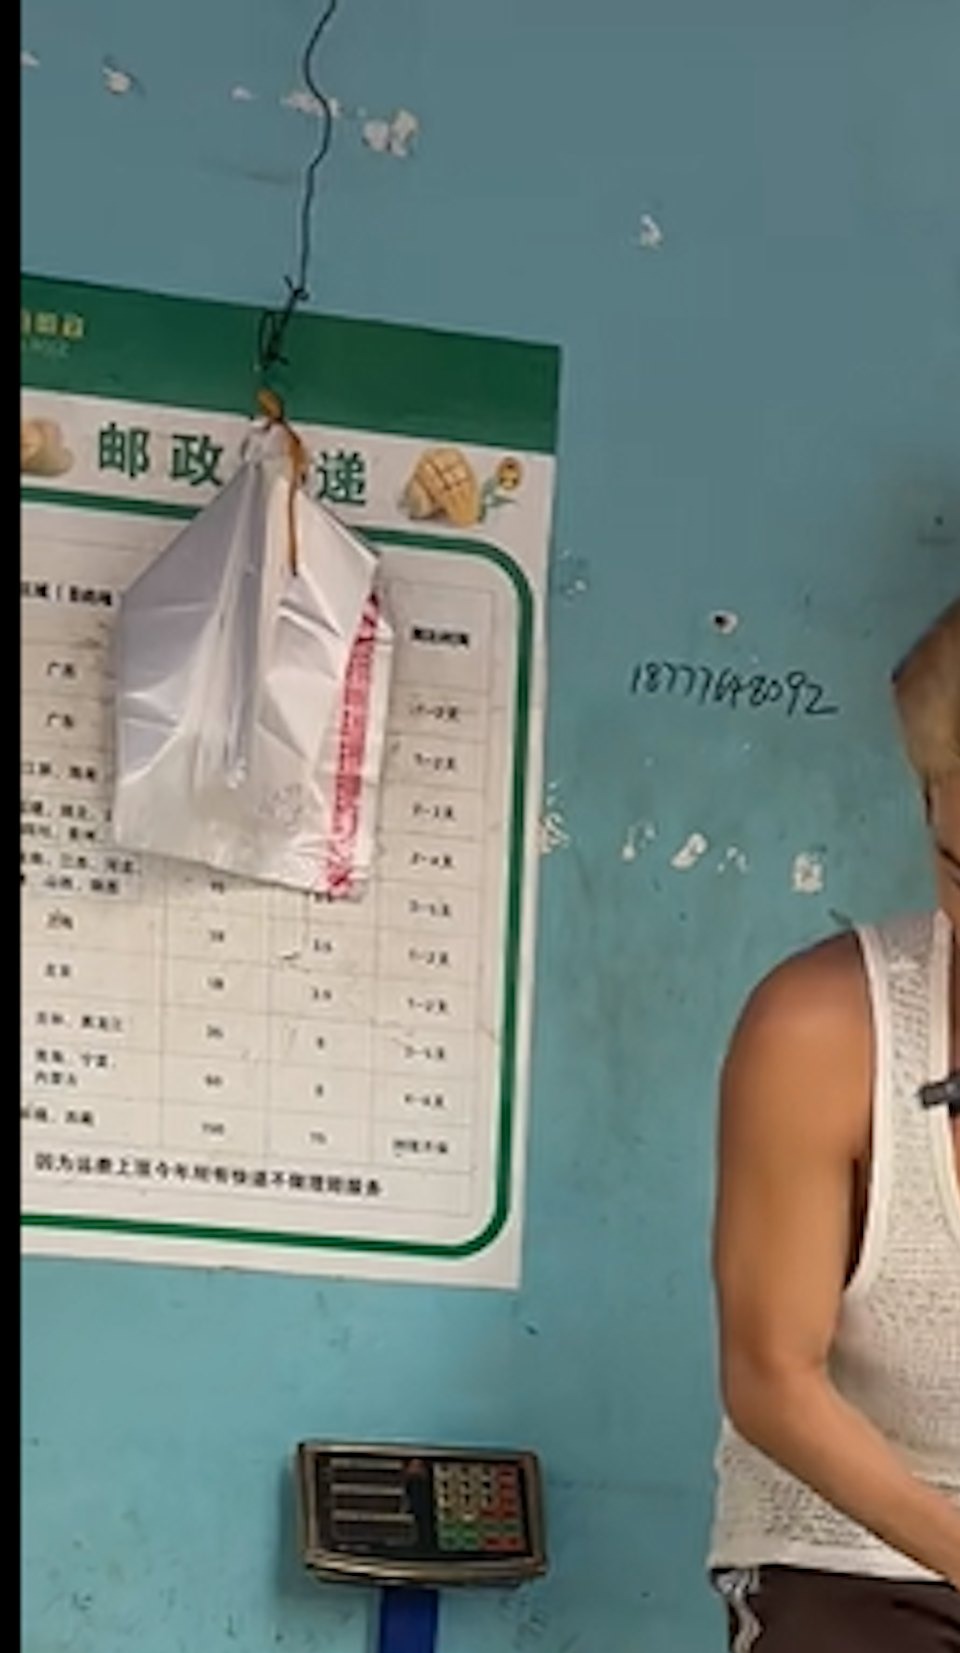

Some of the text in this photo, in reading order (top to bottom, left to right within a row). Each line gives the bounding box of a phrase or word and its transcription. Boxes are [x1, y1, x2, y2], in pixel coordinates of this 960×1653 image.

[98, 422, 366, 506] 邮政递
[631, 661, 839, 716] 18777648092
